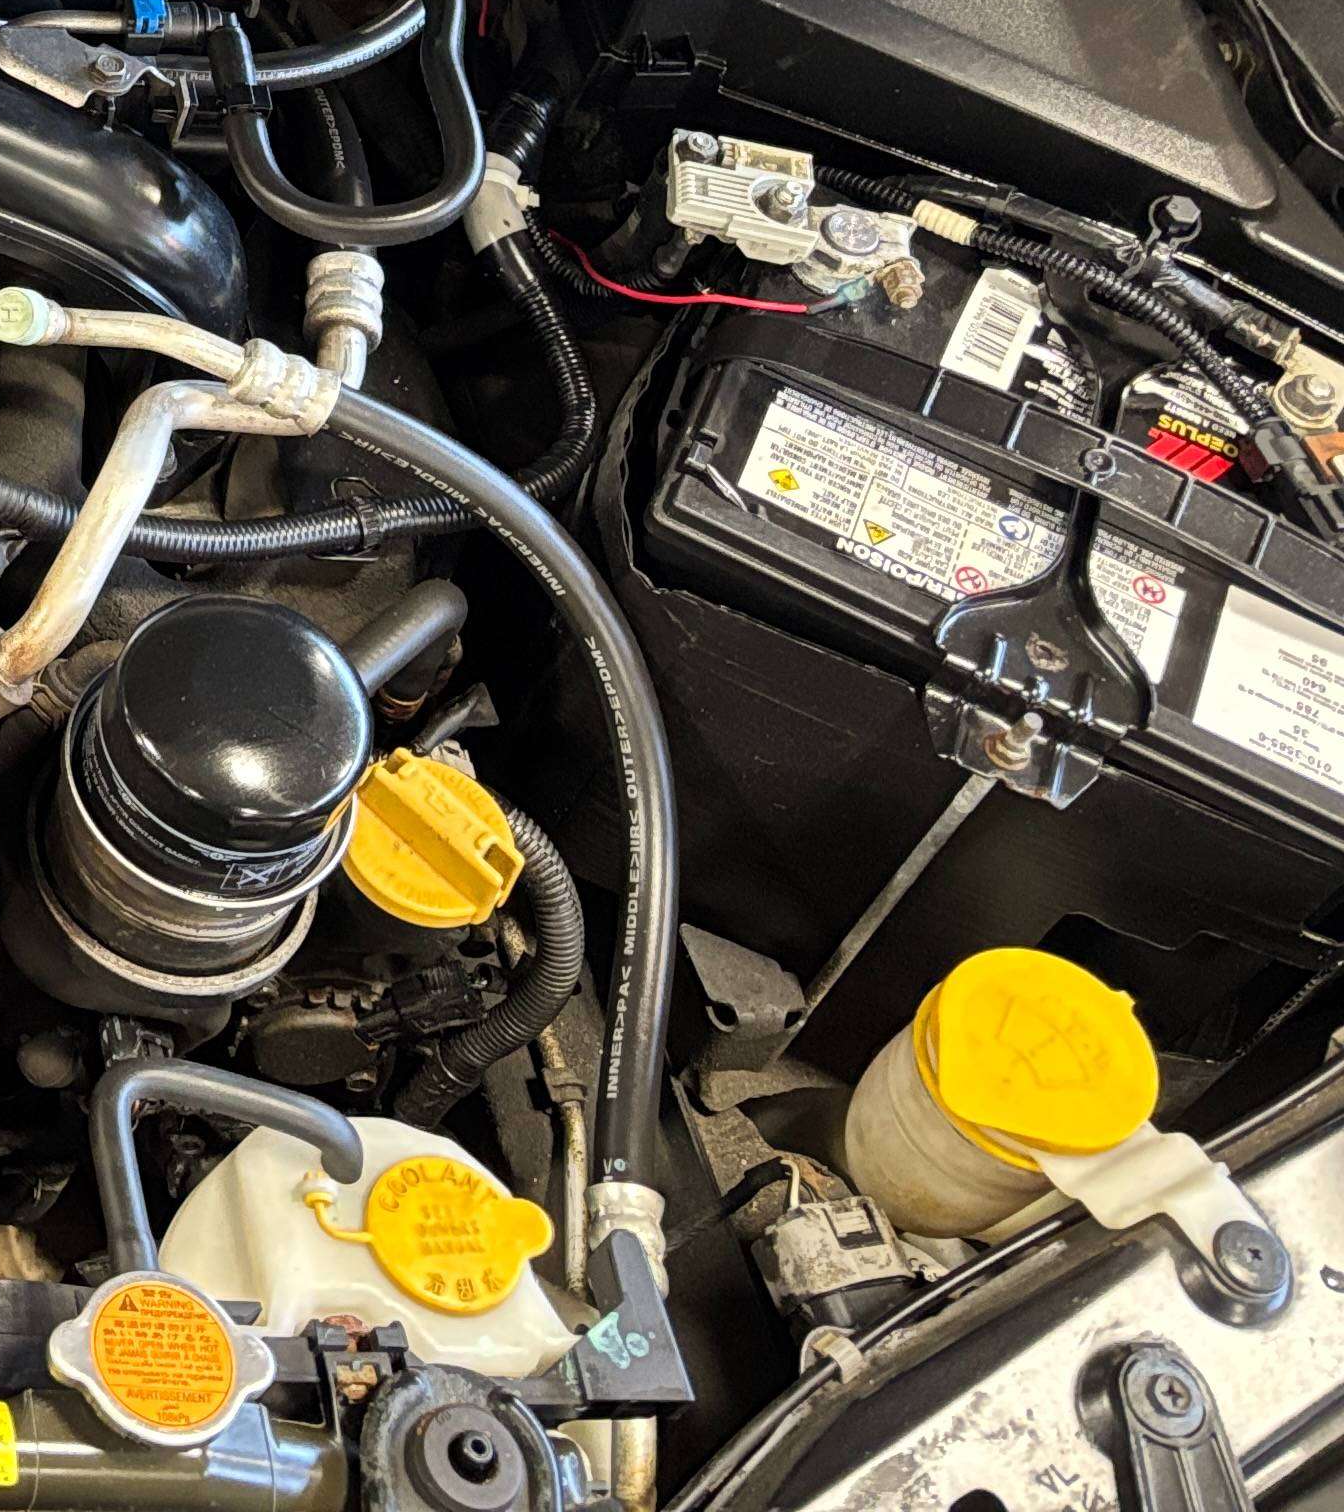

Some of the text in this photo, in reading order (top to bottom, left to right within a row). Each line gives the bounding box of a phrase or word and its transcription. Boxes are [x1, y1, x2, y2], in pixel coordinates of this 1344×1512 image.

[1155, 412, 1240, 460] OEPLUS
[379, 1163, 498, 1212] COOLANT
[140, 1299, 194, 1311] WARNING
[126, 1389, 212, 1404] AVERTISSEMENT
